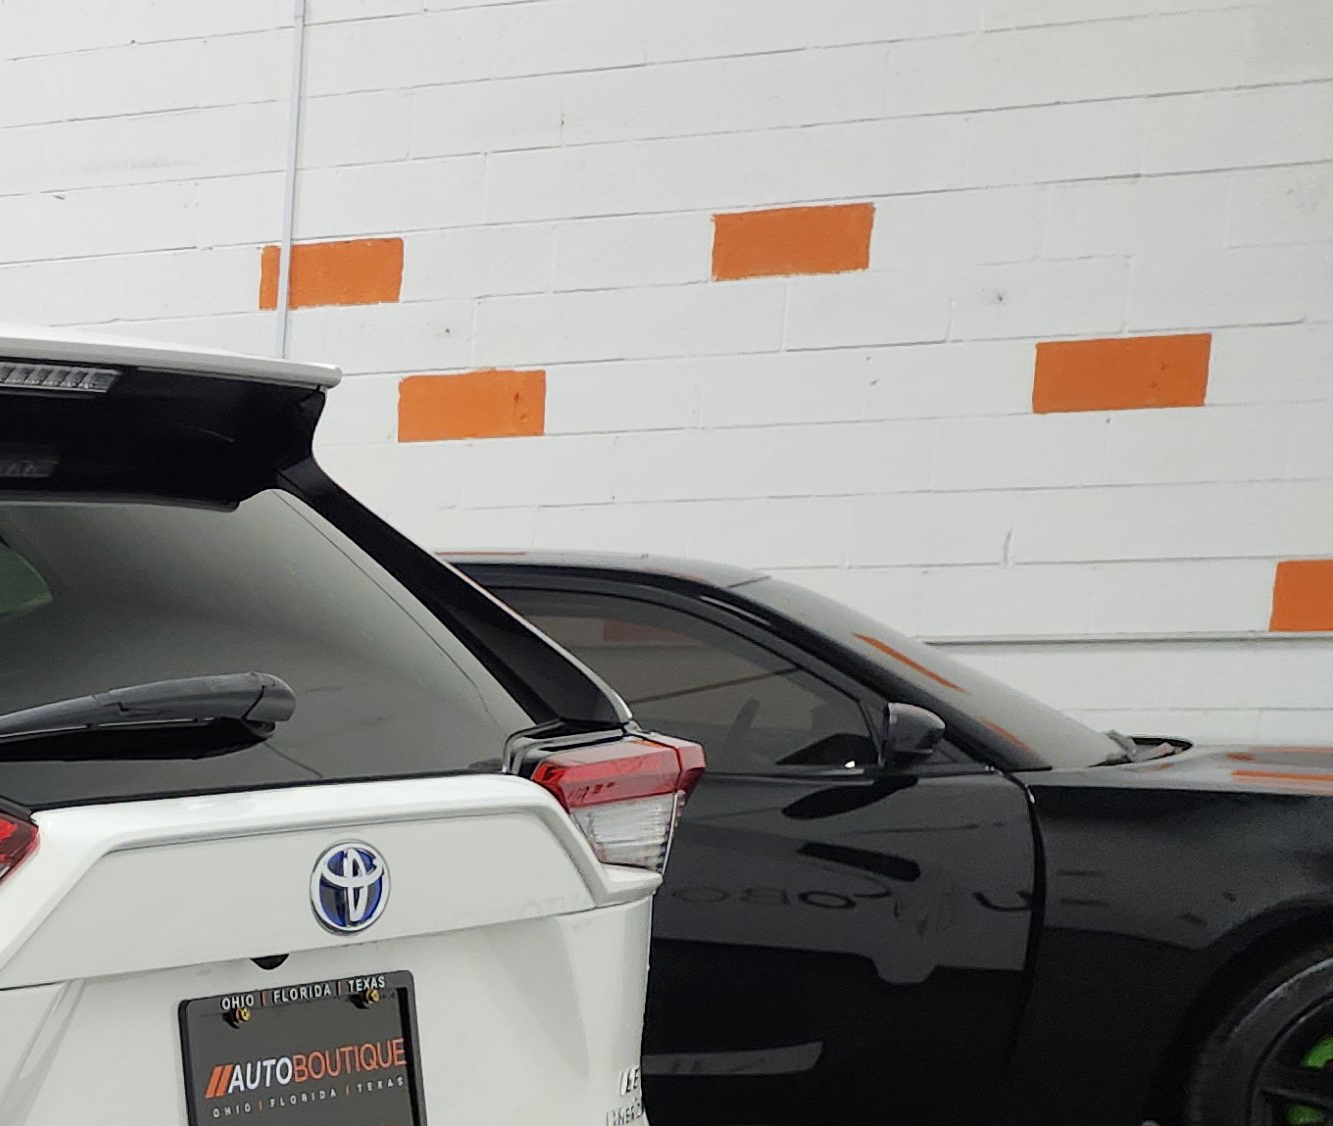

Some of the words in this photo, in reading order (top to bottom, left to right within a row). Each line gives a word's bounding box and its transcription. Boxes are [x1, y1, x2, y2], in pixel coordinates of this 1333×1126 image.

[221, 994, 254, 1010] OHIO
[273, 984, 332, 1003] FLORIDA
[348, 975, 386, 992] TEXAS
[228, 1038, 407, 1093] AUTOBOUTIQUE
[212, 1102, 252, 1118] OHIO
[270, 1088, 337, 1107] FLORIDA
[356, 1076, 405, 1093] TEXAS
